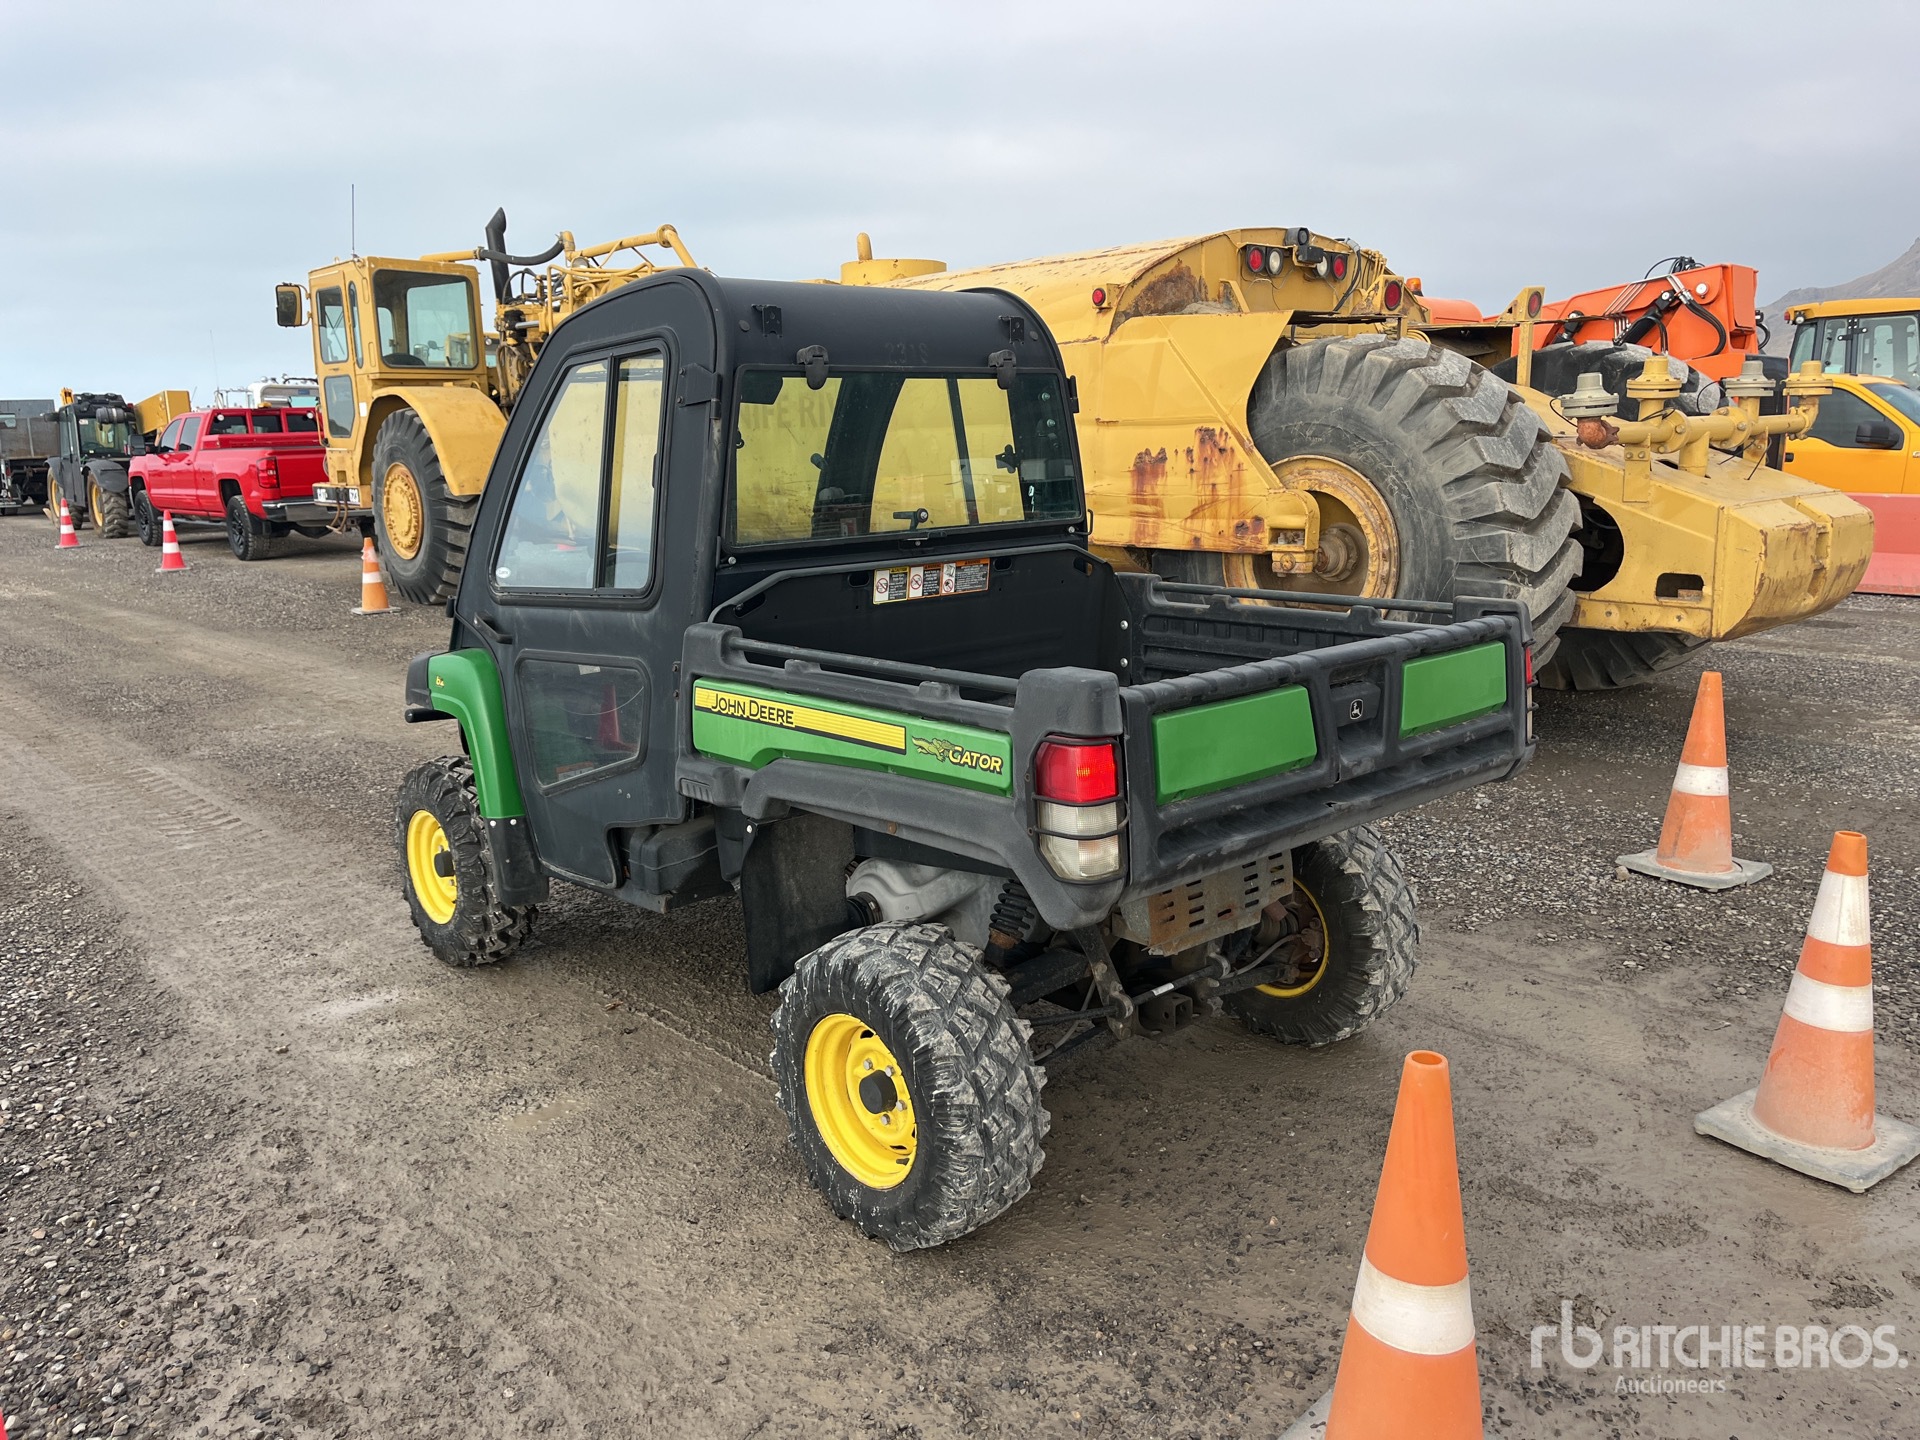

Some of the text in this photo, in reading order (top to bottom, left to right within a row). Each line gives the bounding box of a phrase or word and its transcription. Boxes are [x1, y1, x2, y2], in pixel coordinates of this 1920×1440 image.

[711, 693, 794, 725] JOHN DEERE
[948, 745, 1003, 774] GATOR
